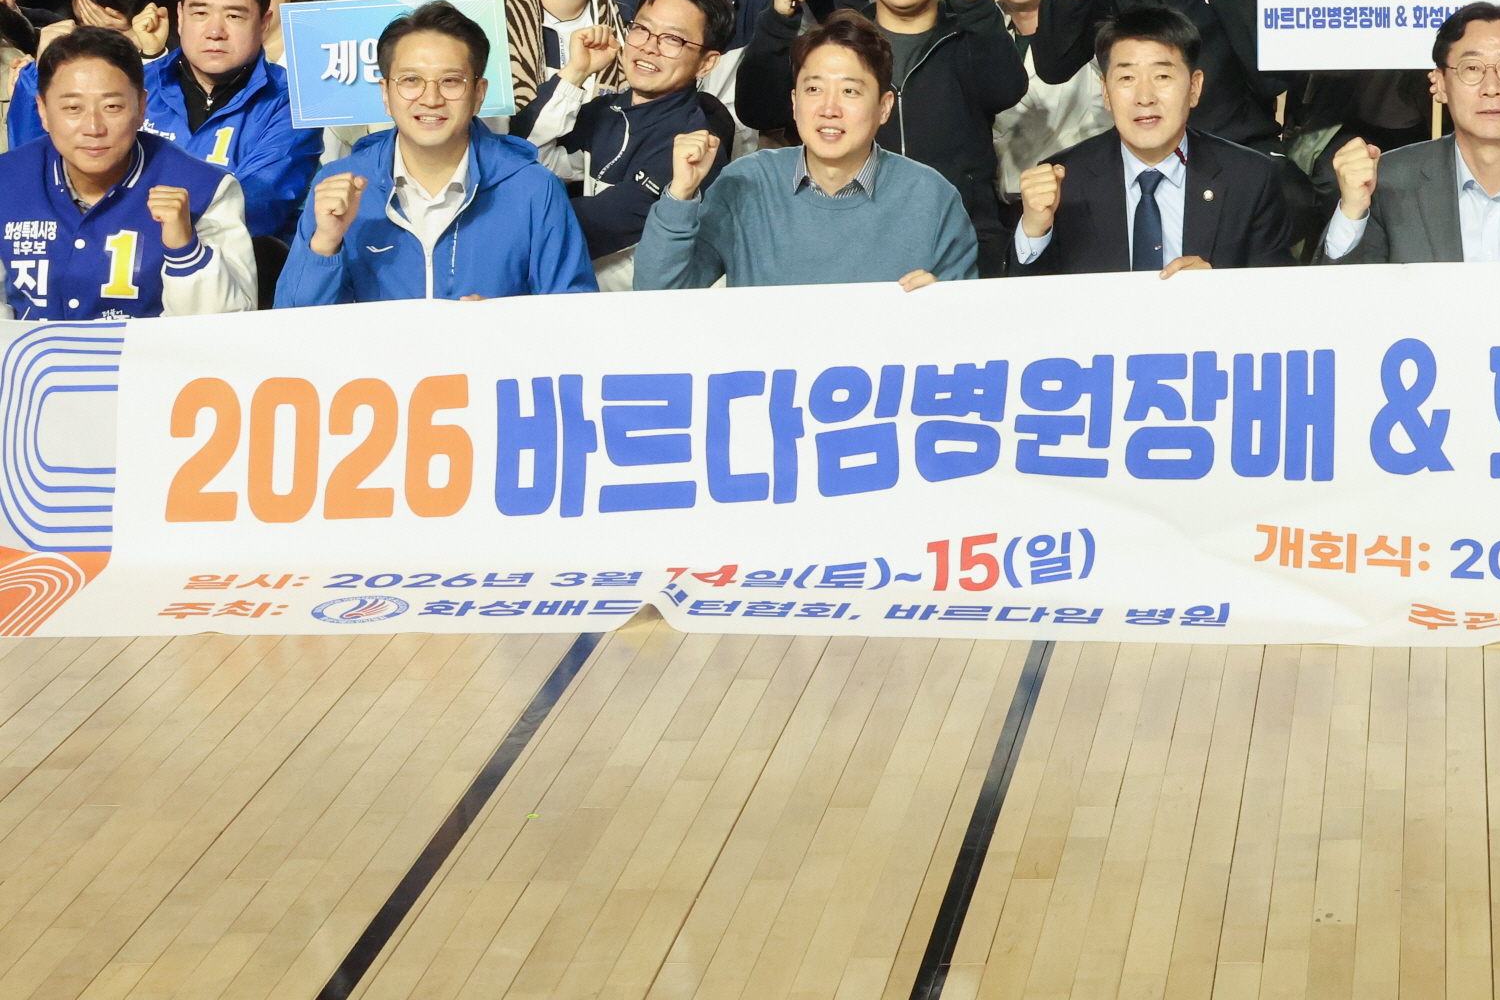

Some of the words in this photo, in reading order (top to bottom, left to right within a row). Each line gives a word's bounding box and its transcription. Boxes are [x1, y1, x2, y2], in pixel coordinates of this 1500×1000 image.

[1264, 6, 1390, 29] 바르다임병원장배
[1395, 5, 1408, 27] &
[206, 126, 235, 167] 1
[4, 220, 58, 241] 화성특례시장
[101, 229, 140, 299] 1
[165, 373, 474, 524] 2026
[495, 349, 1335, 518] 바르다임병원장배
[1369, 337, 1456, 476] &
[1254, 524, 1431, 578] 개회식:
[183, 573, 310, 590] 일시:
[323, 571, 535, 589] 2026년
[550, 571, 642, 588] 3월
[157, 600, 290, 620] 주최:
[883, 602, 1104, 625] 바르다임
[1124, 602, 1231, 629] 병원
